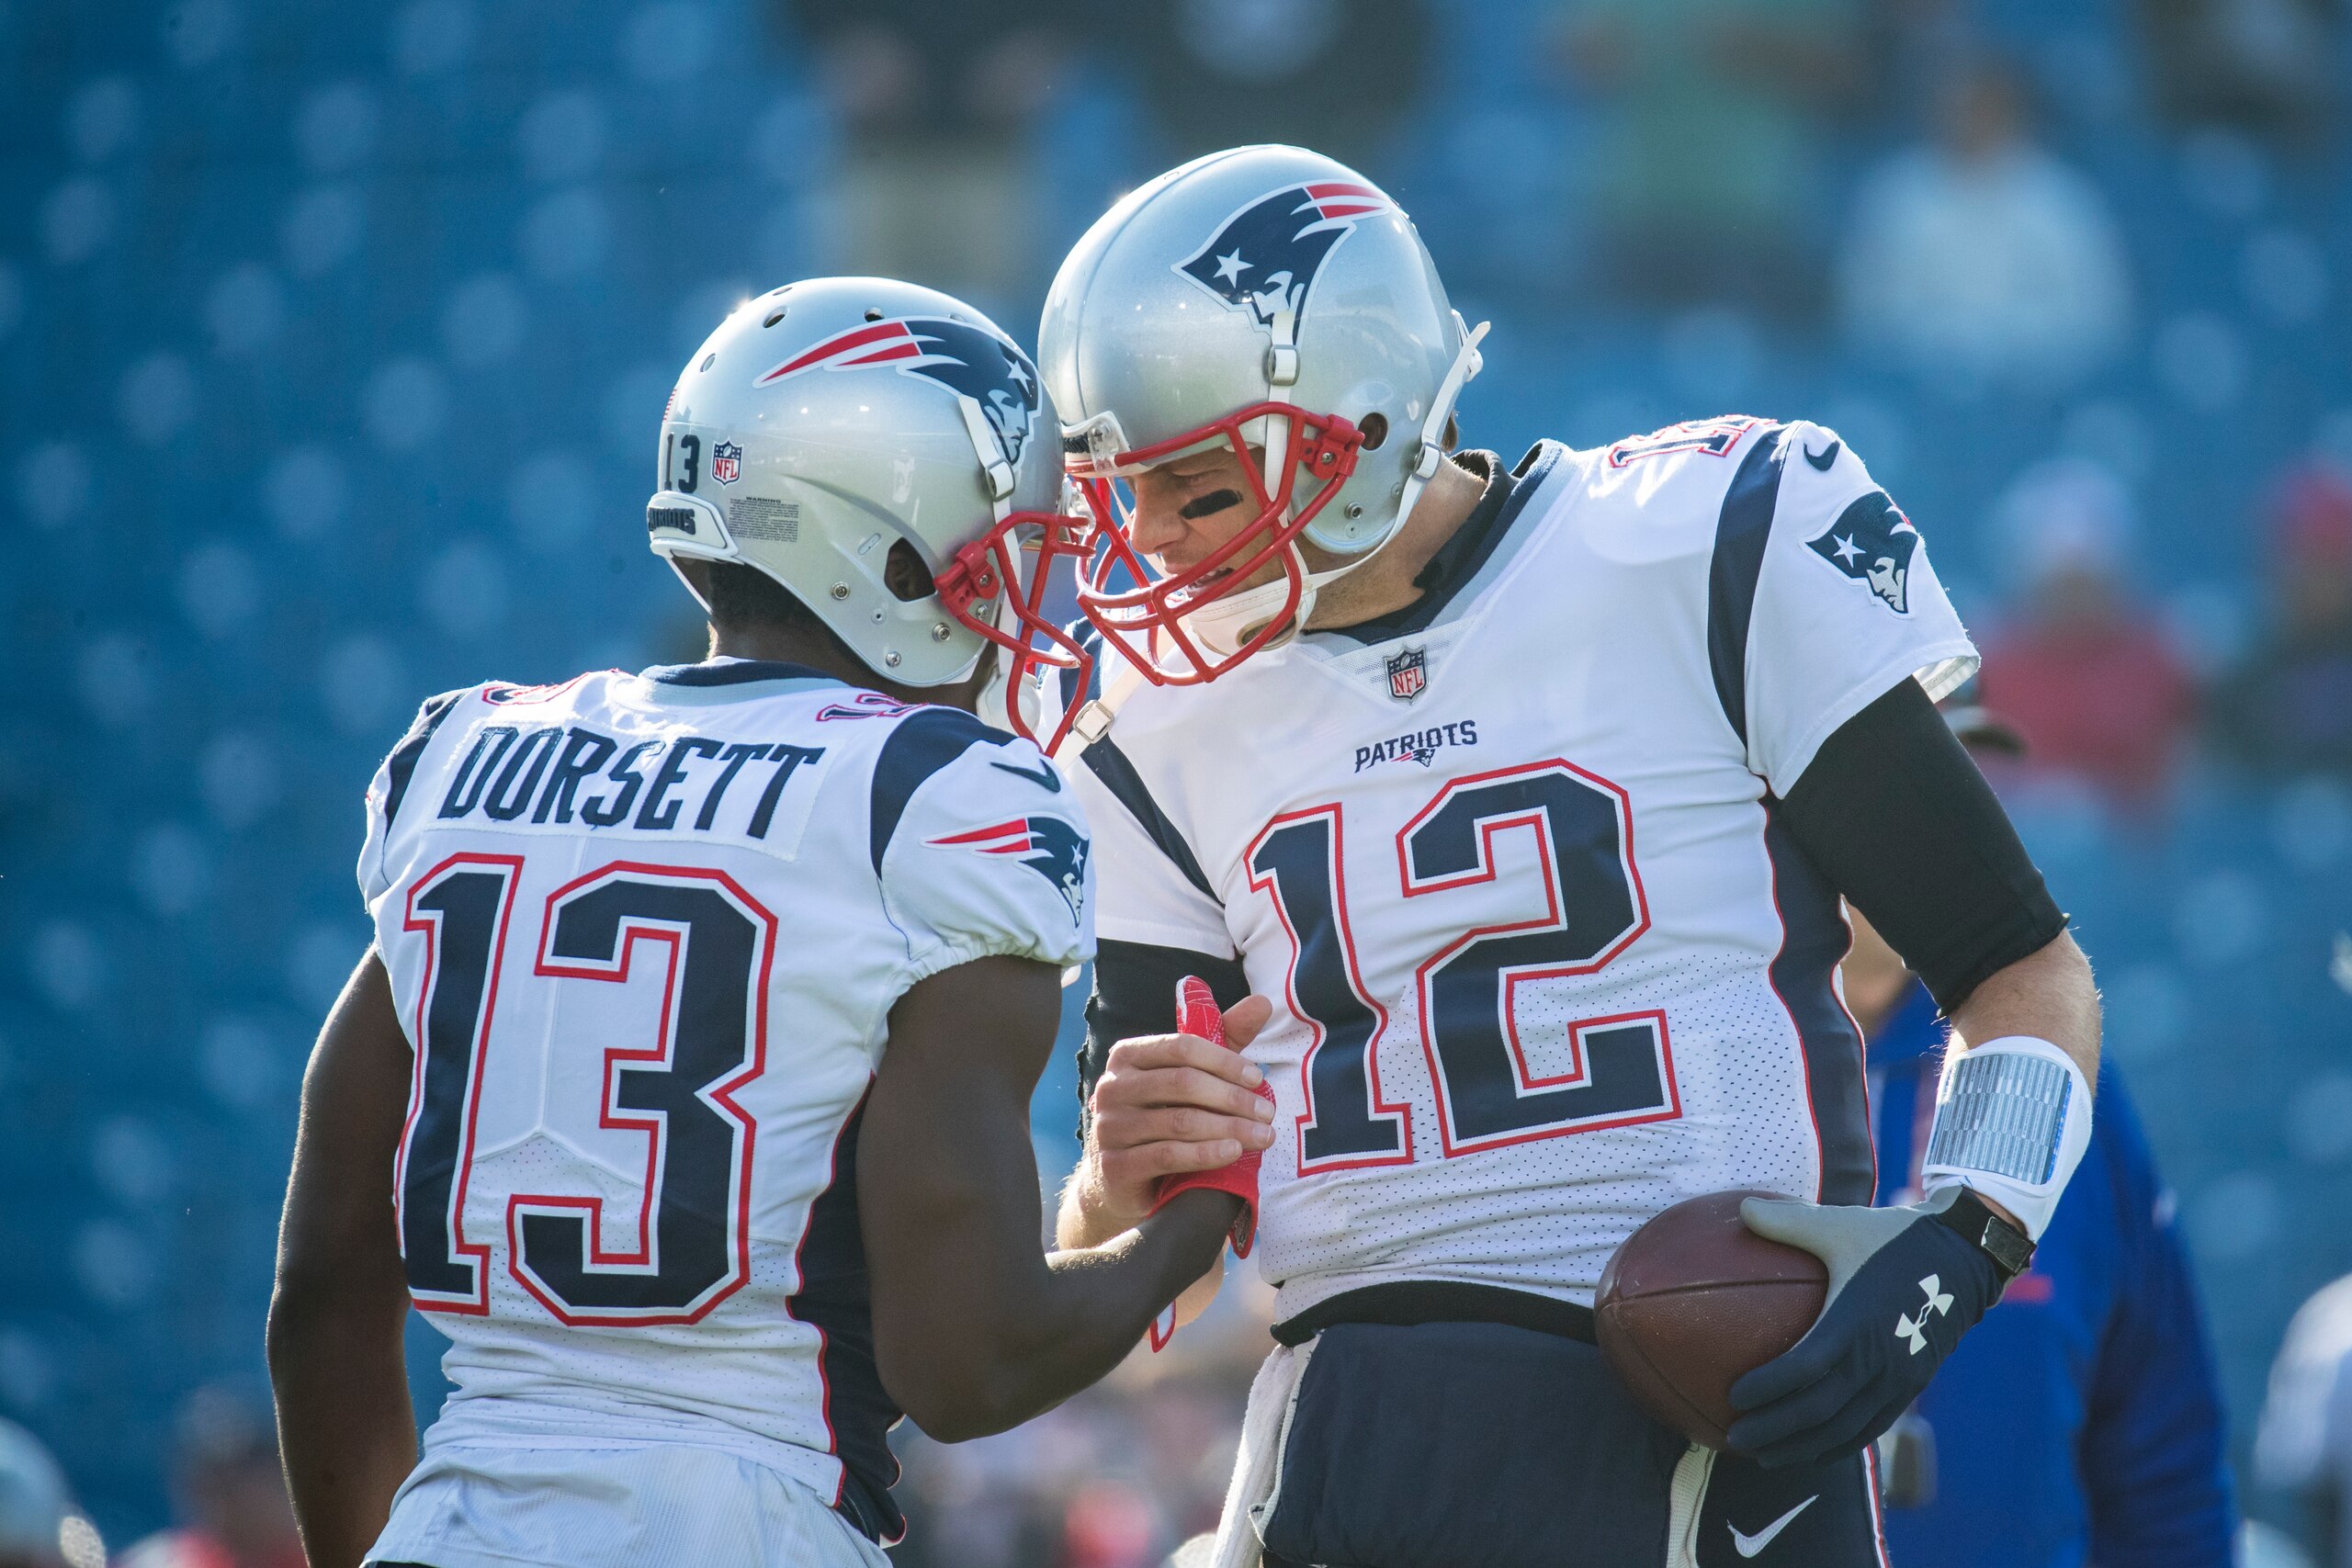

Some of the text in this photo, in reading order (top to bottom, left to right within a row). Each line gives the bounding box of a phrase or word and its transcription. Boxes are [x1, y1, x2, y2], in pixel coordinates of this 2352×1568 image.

[664, 434, 700, 493] 13
[714, 457, 738, 479] NFL
[647, 507, 695, 535] ATRIOTS
[1392, 668, 1423, 694] NFL
[1354, 719, 1478, 773] PATRIOTS
[438, 726, 826, 840] DORSETT
[1243, 757, 1682, 1178] 12
[393, 852, 778, 1325] 13
